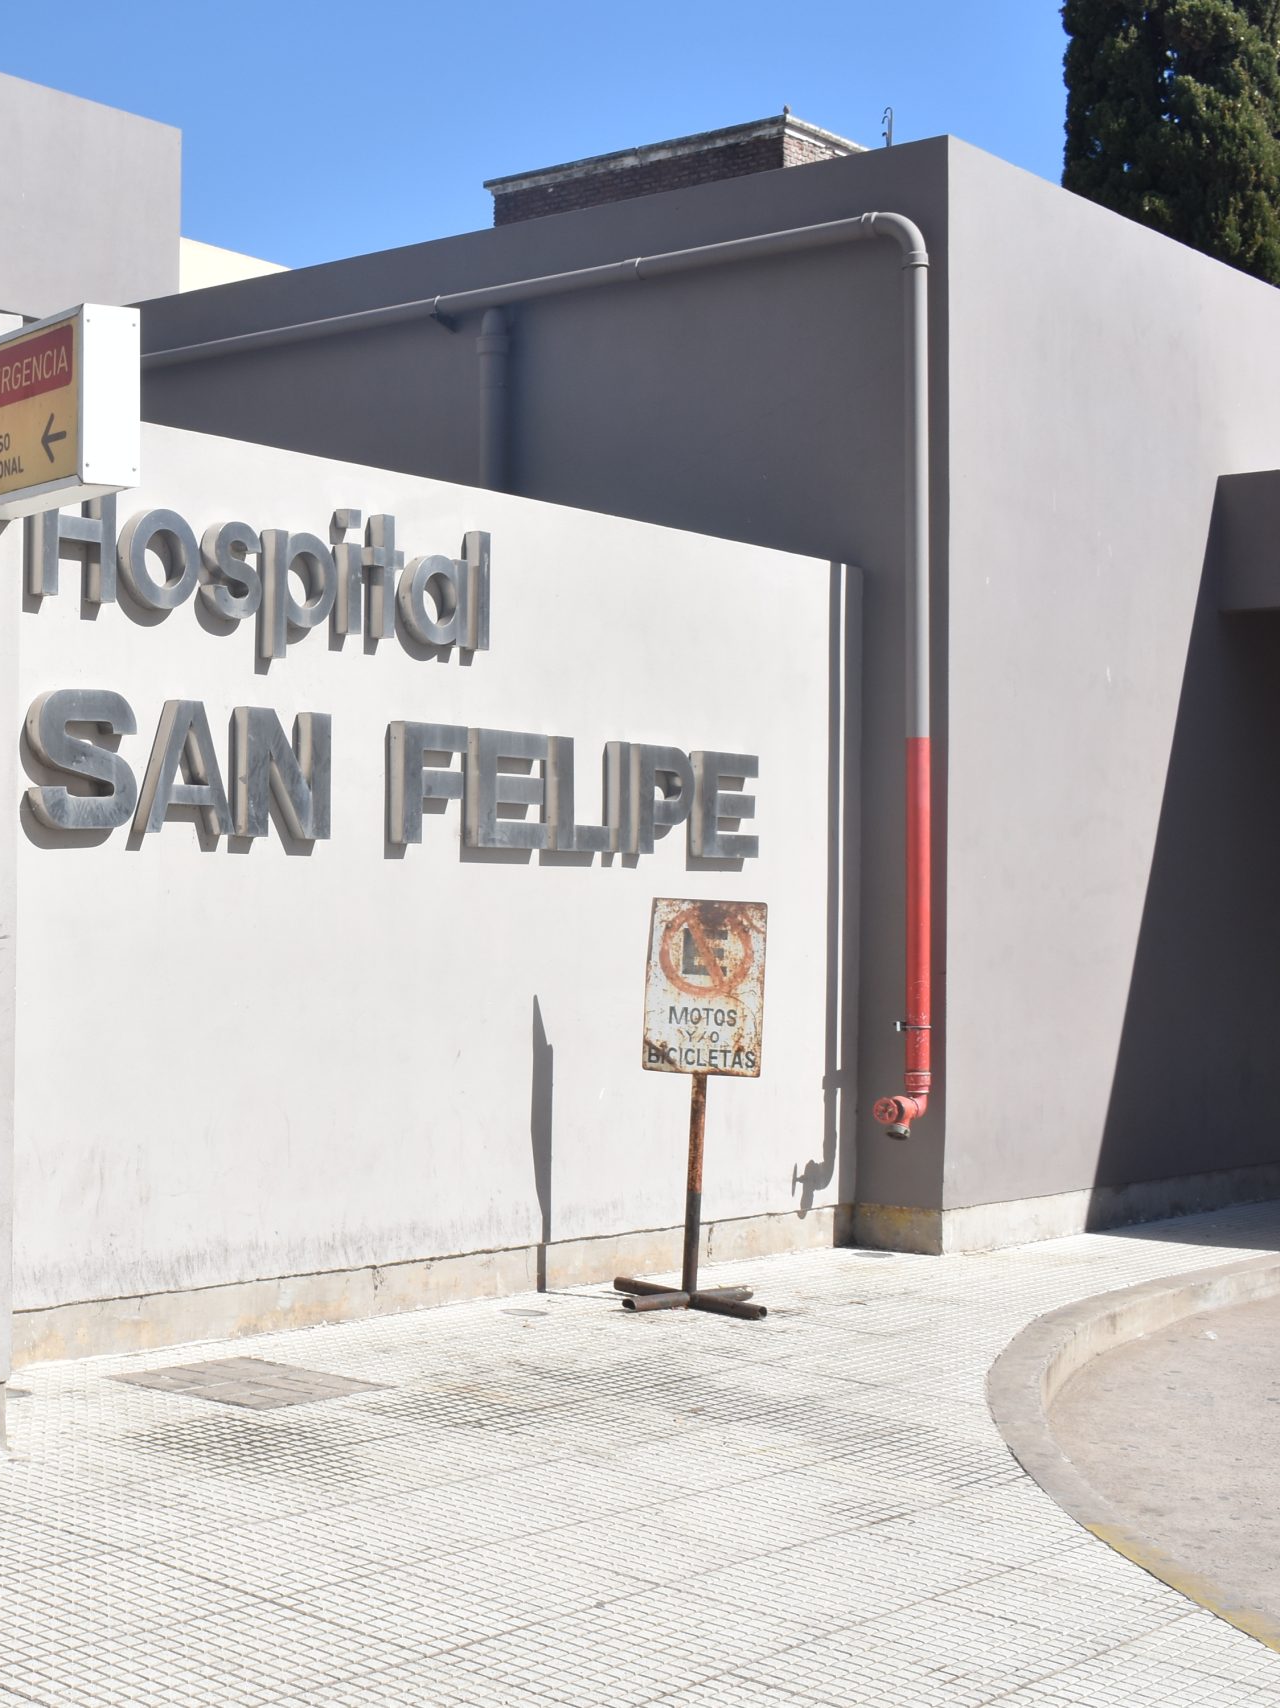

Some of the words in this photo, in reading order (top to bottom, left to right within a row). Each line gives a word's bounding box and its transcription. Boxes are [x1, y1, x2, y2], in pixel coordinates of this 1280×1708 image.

[29, 492, 491, 660] Hospital
[26, 688, 332, 840] SAN
[389, 720, 760, 859] FELIPE
[647, 1046, 756, 1069] BICICLETAS
[669, 1005, 737, 1027] MOTOS
